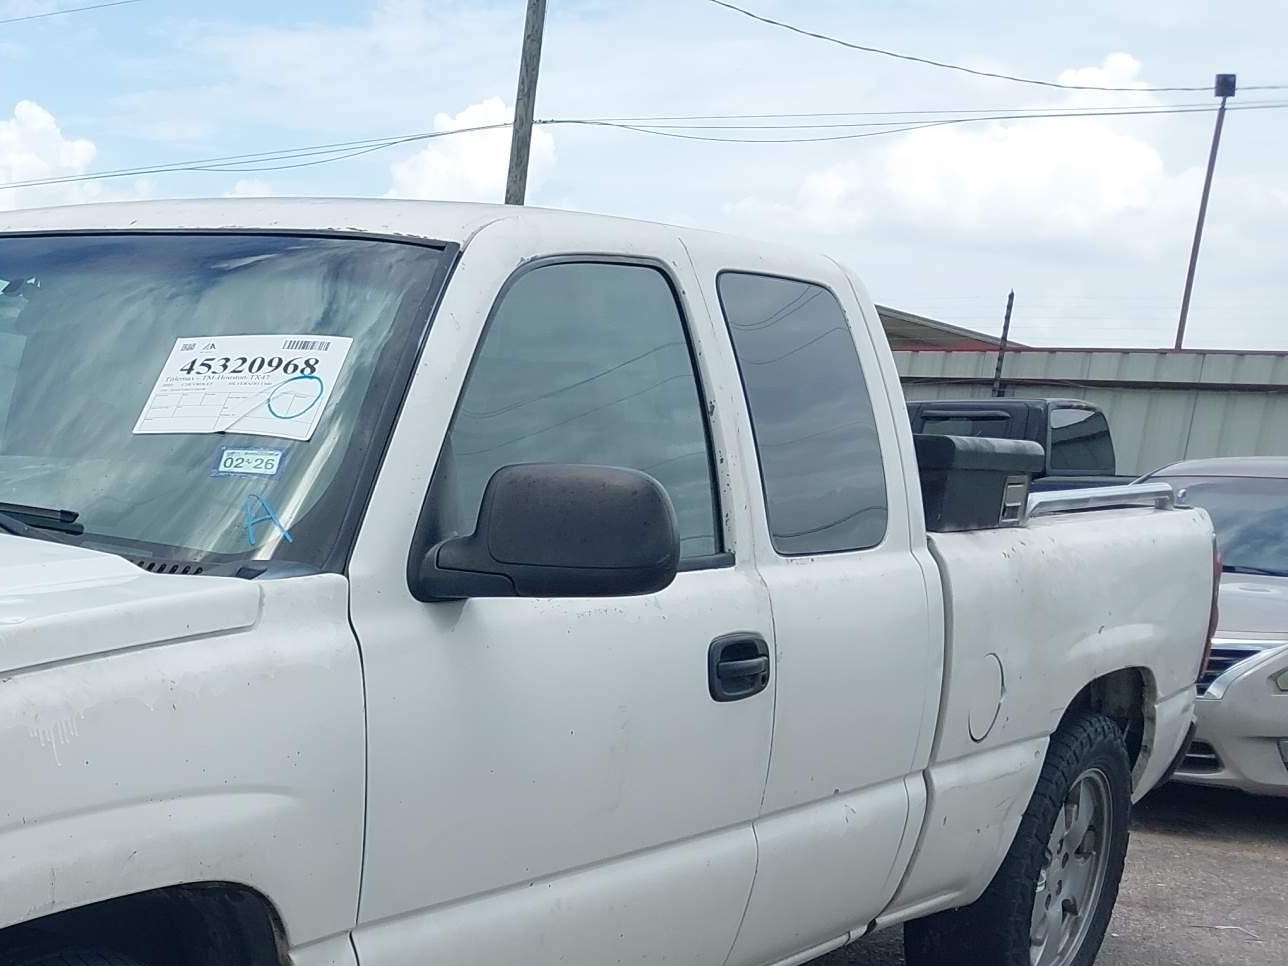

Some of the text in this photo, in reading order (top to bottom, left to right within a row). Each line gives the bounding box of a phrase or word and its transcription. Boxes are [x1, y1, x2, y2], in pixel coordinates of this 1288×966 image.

[179, 356, 320, 376] 45320968
[223, 457, 275, 470] 02 26
[247, 493, 293, 546] A
